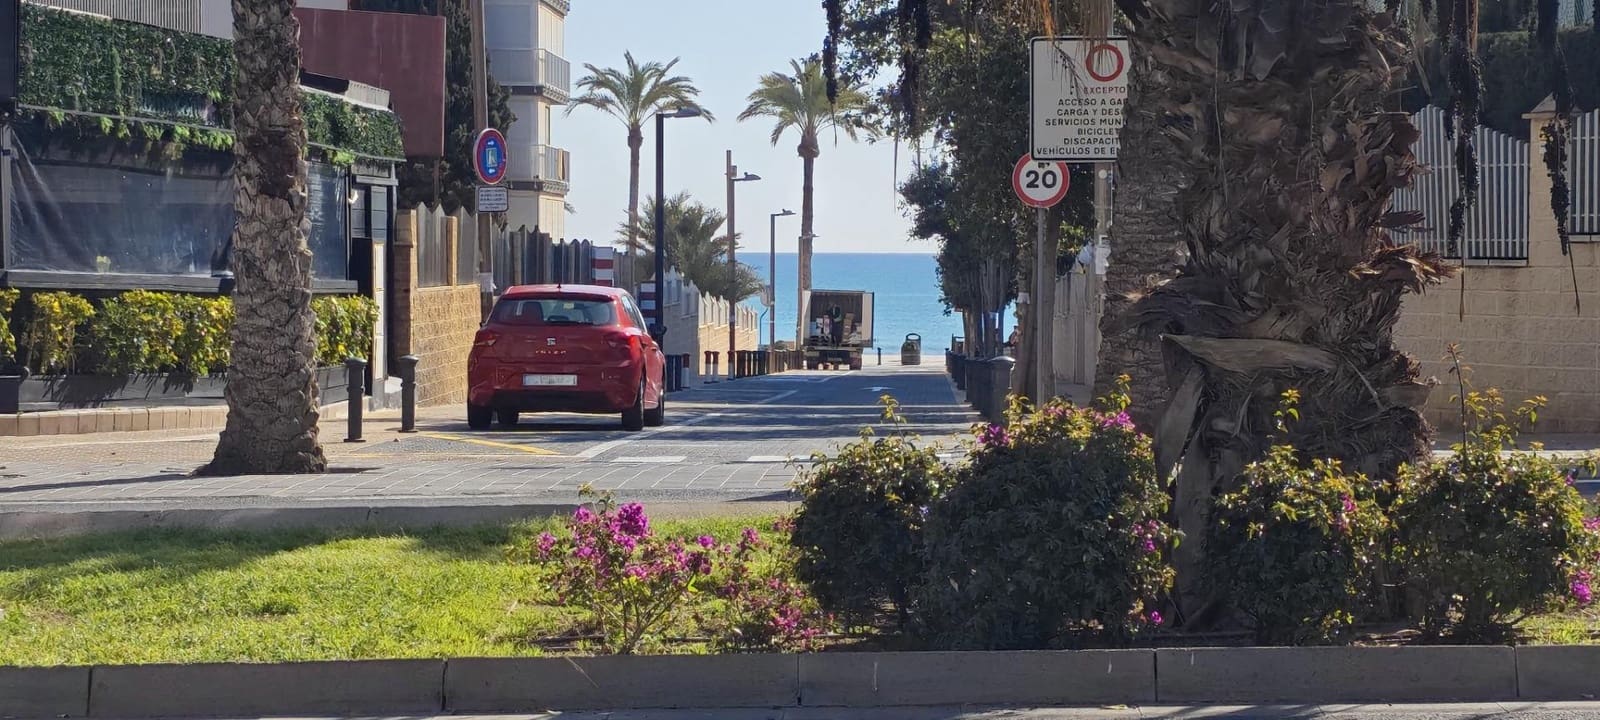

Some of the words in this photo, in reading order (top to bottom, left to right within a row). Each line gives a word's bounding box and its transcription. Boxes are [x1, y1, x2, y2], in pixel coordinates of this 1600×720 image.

[1083, 86, 1126, 95] EXCEPTO
[1058, 98, 1097, 106] ACCESO
[1100, 98, 1106, 106] A
[1056, 108, 1089, 116] CARGA
[1092, 108, 1098, 116] Y
[1101, 108, 1123, 116] DES
[1045, 118, 1096, 126] SERVICIOS
[1036, 146, 1090, 155] VEHÍCULOS
[1094, 147, 1106, 155] DE
[1026, 170, 1057, 189] 20
